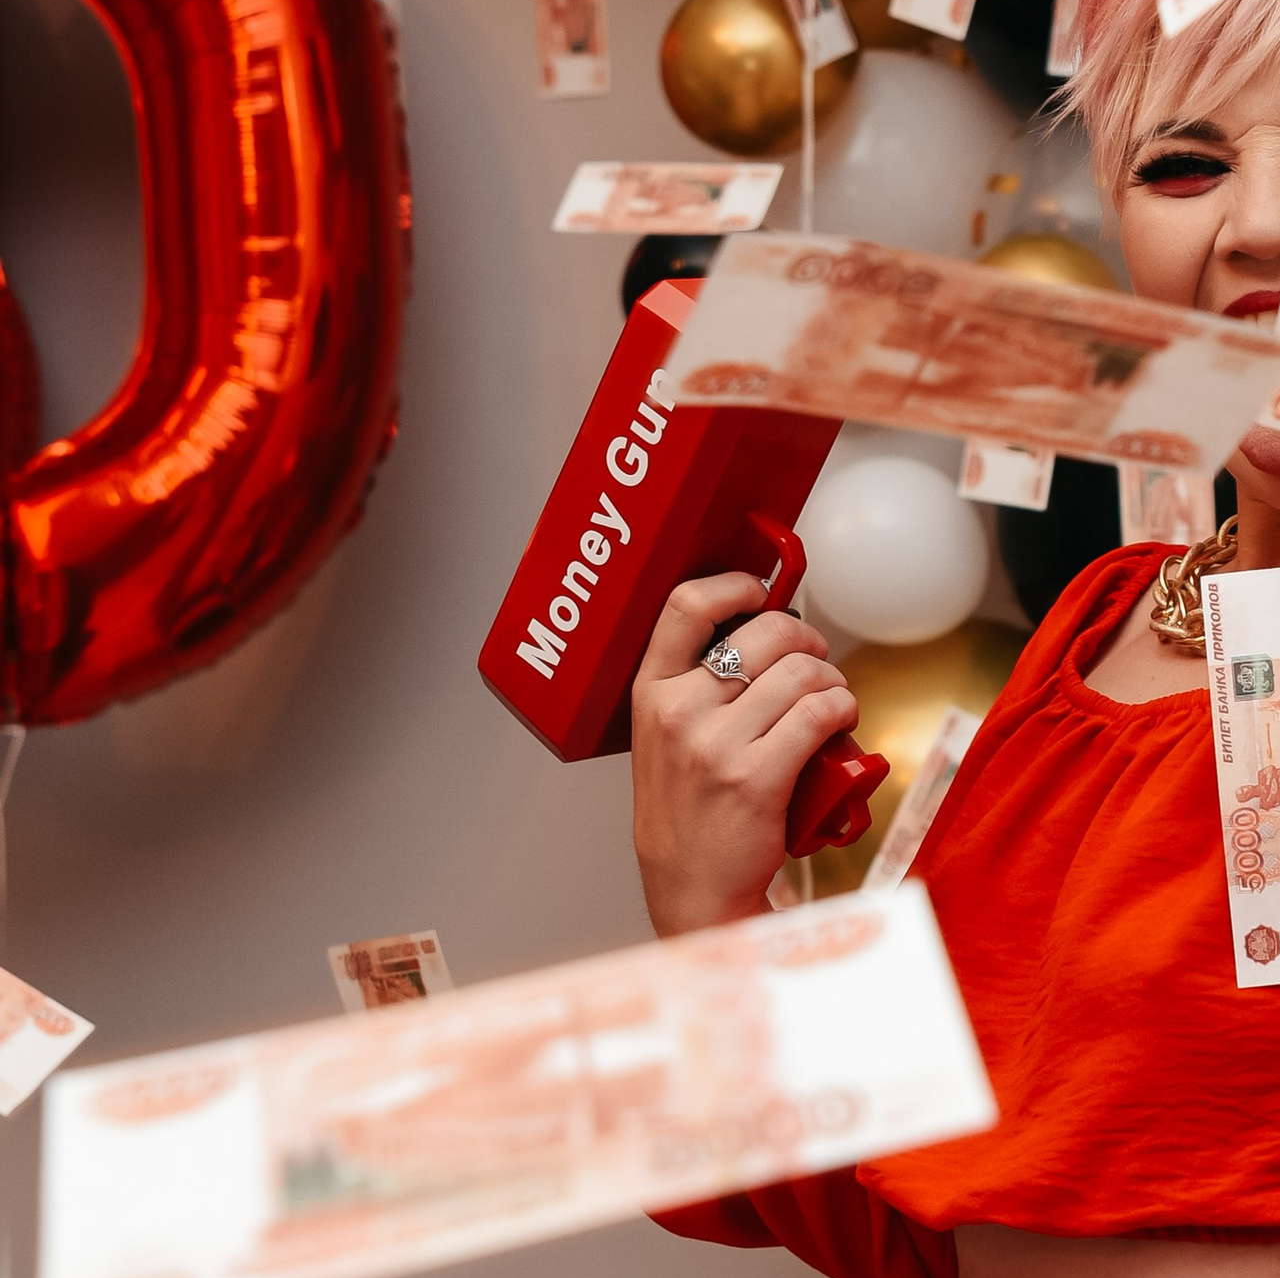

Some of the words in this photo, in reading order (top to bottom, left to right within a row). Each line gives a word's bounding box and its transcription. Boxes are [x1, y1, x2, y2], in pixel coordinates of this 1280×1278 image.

[515, 492, 632, 680] Money
[604, 367, 677, 487] Gun
[1207, 582, 1225, 662] ПРИКОЛОВ
[1214, 666, 1229, 715] БАНКА
[1219, 716, 1234, 764] БИЛЕТ
[1230, 806, 1267, 895] 5000
